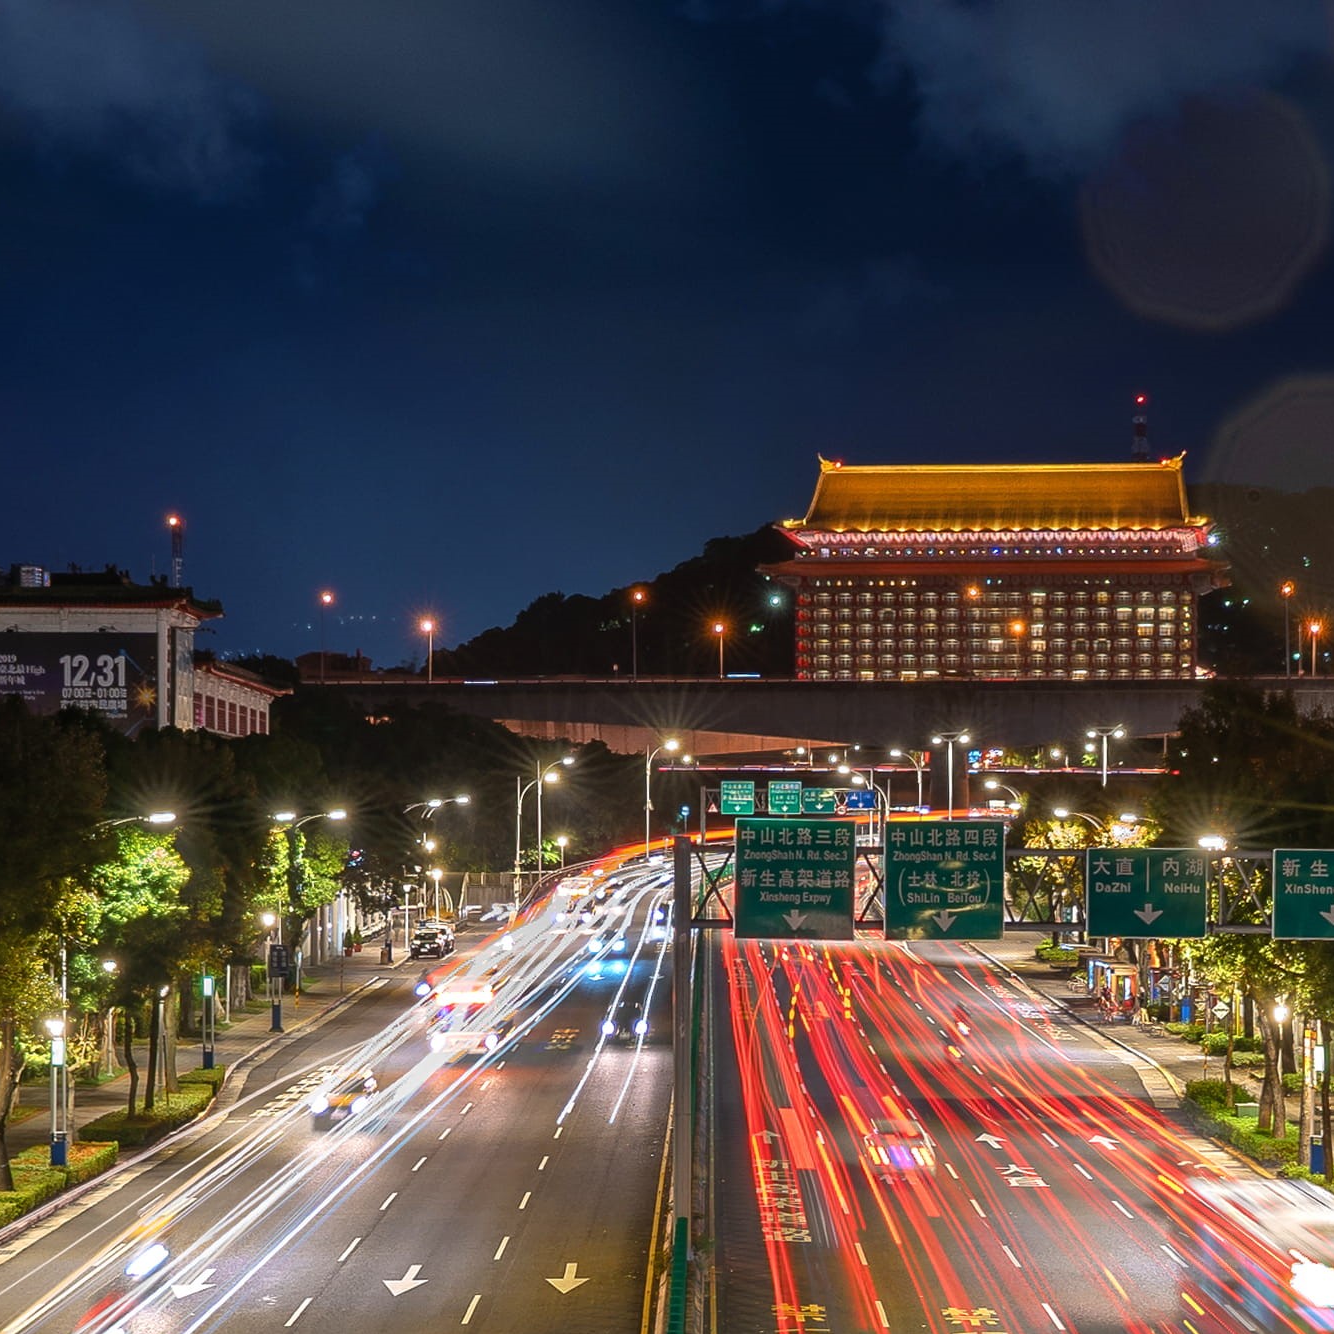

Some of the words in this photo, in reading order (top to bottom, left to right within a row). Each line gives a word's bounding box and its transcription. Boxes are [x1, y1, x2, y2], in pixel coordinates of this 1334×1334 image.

[59, 653, 127, 687] 12/31
[741, 827, 852, 846] 中山北路三段
[891, 828, 998, 847] 中山北路四段
[796, 850, 805, 860] N.
[807, 850, 822, 860] Rd.
[824, 850, 848, 860] Sec.3
[893, 851, 943, 862] ZhongShan
[945, 851, 953, 861] N.
[956, 851, 971, 861] Rd.
[973, 851, 996, 861] Sec.4
[1092, 857, 1135, 877] 大直
[1162, 857, 1204, 876] 內湖
[741, 868, 851, 888] 新生高架道路
[1095, 882, 1132, 893] DaZhi
[1164, 882, 1200, 893] NeiHu
[760, 891, 801, 904] Xinsheng
[803, 891, 831, 904] Expwy
[907, 892, 940, 903] ShiLin
[948, 892, 981, 903] BeiTou
